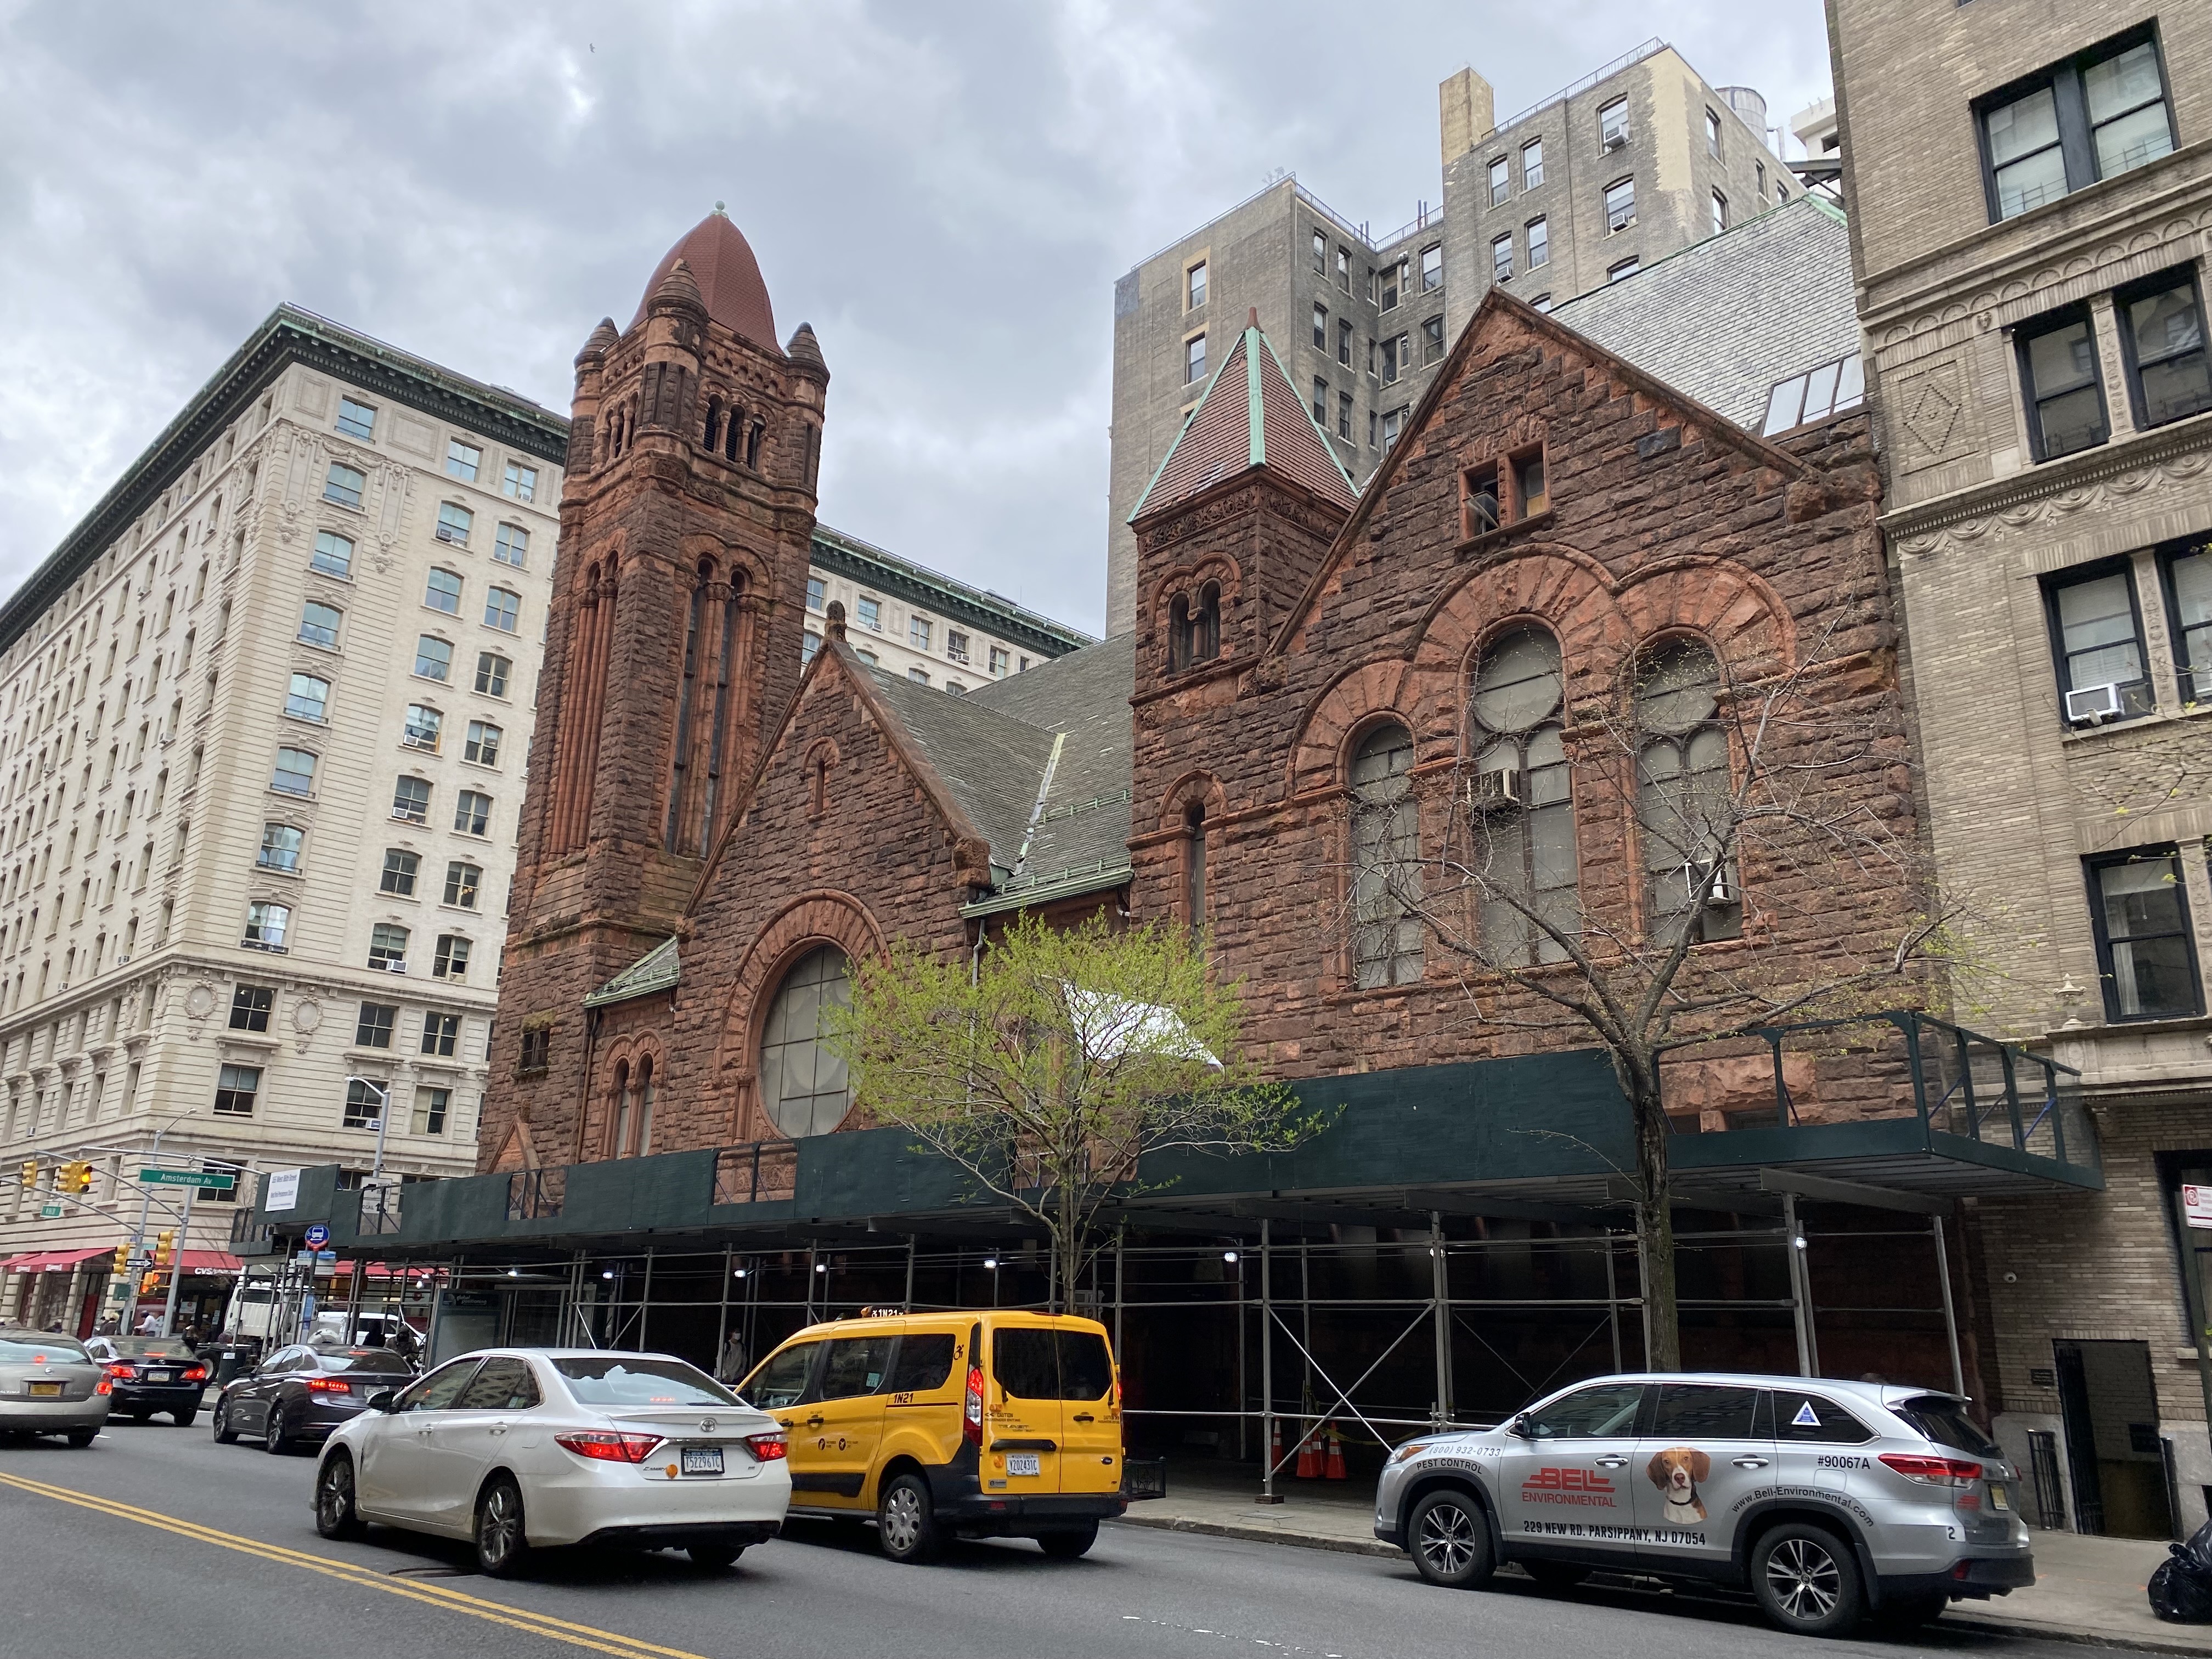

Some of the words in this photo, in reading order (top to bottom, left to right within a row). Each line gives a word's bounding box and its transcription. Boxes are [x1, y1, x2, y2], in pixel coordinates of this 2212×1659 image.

[160, 1173, 201, 1184] Amsterdam
[878, 1308, 898, 1317] 1N21
[894, 1392, 914, 1403] 1N21
[1429, 1446, 1454, 1454] (800)
[1455, 1446, 1500, 1457] 932-0733
[1009, 1459, 1037, 1470] Y202431C
[1417, 1459, 1438, 1470] PEST
[1441, 1459, 1482, 1474] CONTROL
[1817, 1455, 1871, 1470] #90067A
[1522, 1468, 1616, 1493] BELL
[1522, 1492, 1617, 1508] ENVIRONMENTAL
[1732, 1487, 1874, 1527] www.Bell-Environmental.com
[1524, 1520, 1542, 1533] 229
[1545, 1522, 1566, 1535] NEW
[1570, 1523, 1585, 1536] RD.
[1589, 1525, 1651, 1543] PARSIPPANY,
[1655, 1530, 1668, 1543] NJ
[1672, 1531, 1706, 1545] 07054
[1948, 1527, 1956, 1540] 2
